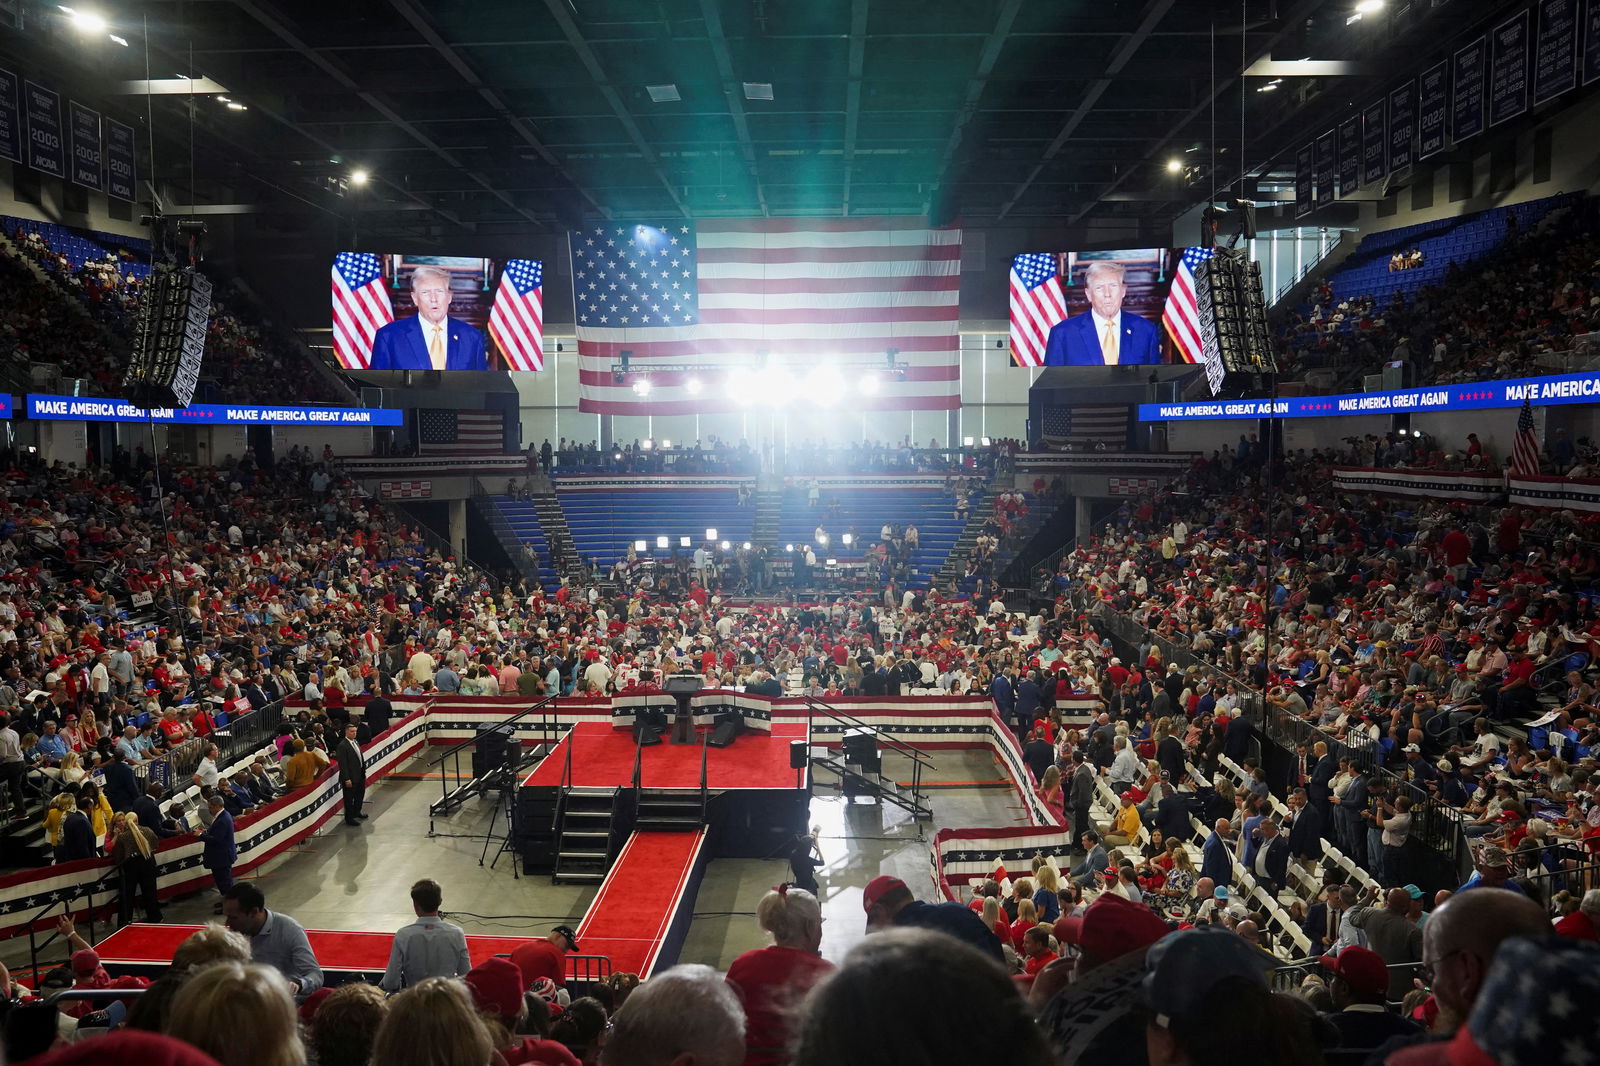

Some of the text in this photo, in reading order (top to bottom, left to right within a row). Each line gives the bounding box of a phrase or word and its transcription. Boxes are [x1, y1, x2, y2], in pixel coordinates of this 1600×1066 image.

[1421, 107, 1444, 130] 2022
[31, 127, 59, 149] 2003
[1392, 125, 1412, 145] 2019
[1422, 136, 1440, 153] NCAA
[75, 143, 101, 164] 2002
[1391, 152, 1409, 168] NCAA
[35, 154, 57, 171] NCAA
[110, 158, 131, 177] 2001
[78, 168, 98, 185] NCAA
[1366, 166, 1381, 181] NCAA
[112, 182, 131, 197] NCAA
[1506, 379, 1600, 400] MAKE AMERICA
[35, 400, 68, 414] MAKE
[70, 402, 115, 416] AMERICA
[1338, 391, 1449, 410] MAKE AMERICA GREAT AGAIN
[227, 409, 370, 422] MAKE AMERICA GREAT AGAIN
[1160, 403, 1288, 416] MAKE AMERICA GREAT AGAIN
